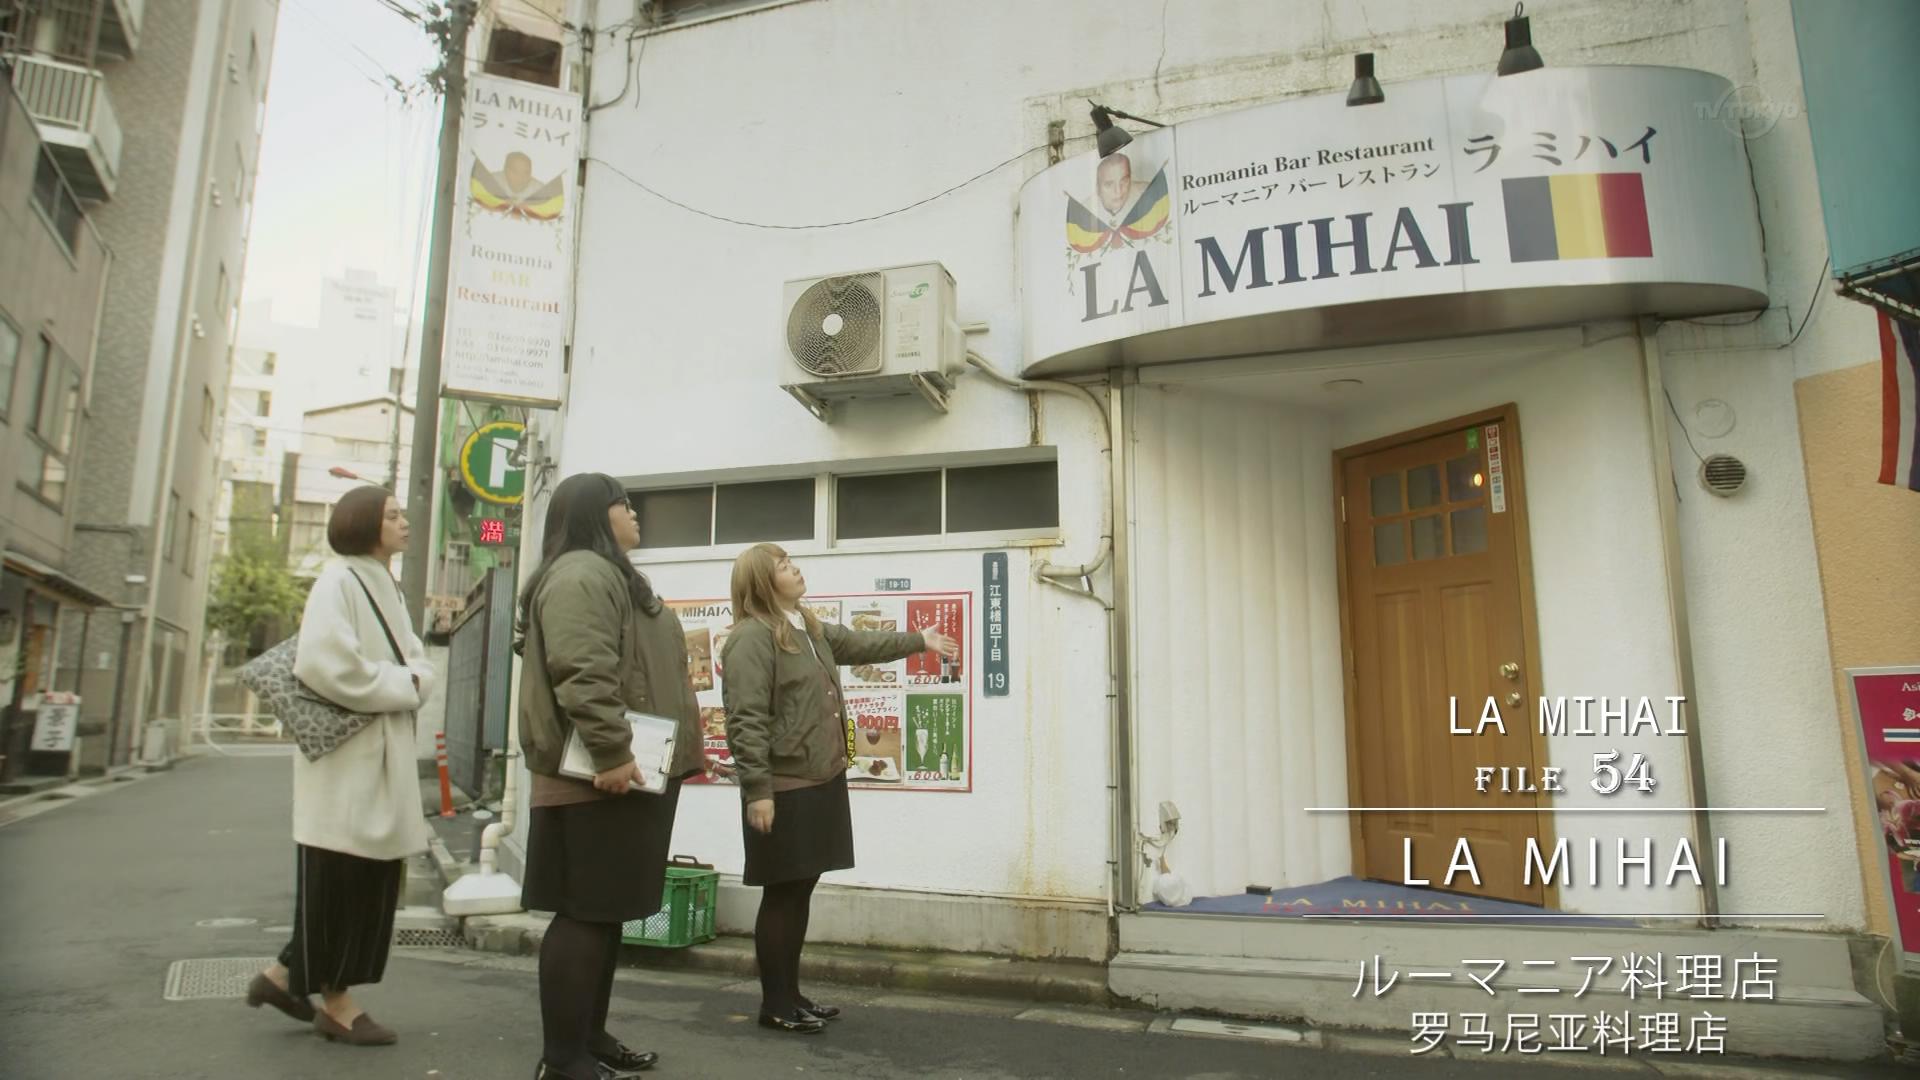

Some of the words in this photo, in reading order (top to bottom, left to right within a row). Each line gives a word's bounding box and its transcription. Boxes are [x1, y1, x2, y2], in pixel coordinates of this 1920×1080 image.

[475, 88, 501, 108] LA
[508, 95, 573, 123] MIHAI
[1182, 161, 1269, 191] Romania
[1275, 152, 1311, 173] Bar
[1317, 137, 1436, 165] Restaurant
[1463, 134, 1502, 174] ラ
[1531, 126, 1657, 166] ミハイ
[1183, 183, 1281, 216] ルーマニア
[1287, 177, 1328, 195] バー
[1337, 162, 1441, 189] レストラン
[470, 243, 553, 271] Romania
[1079, 249, 1169, 323] LA
[1194, 201, 1481, 300] MIHAI
[491, 270, 532, 288] BAR
[456, 286, 561, 314] Restaurant
[489, 437, 527, 488] P
[480, 519, 505, 543] 満
[989, 584, 1003, 661] 江東橋四丁目
[987, 673, 1005, 689] 19
[1263, 895, 1313, 907] LA
